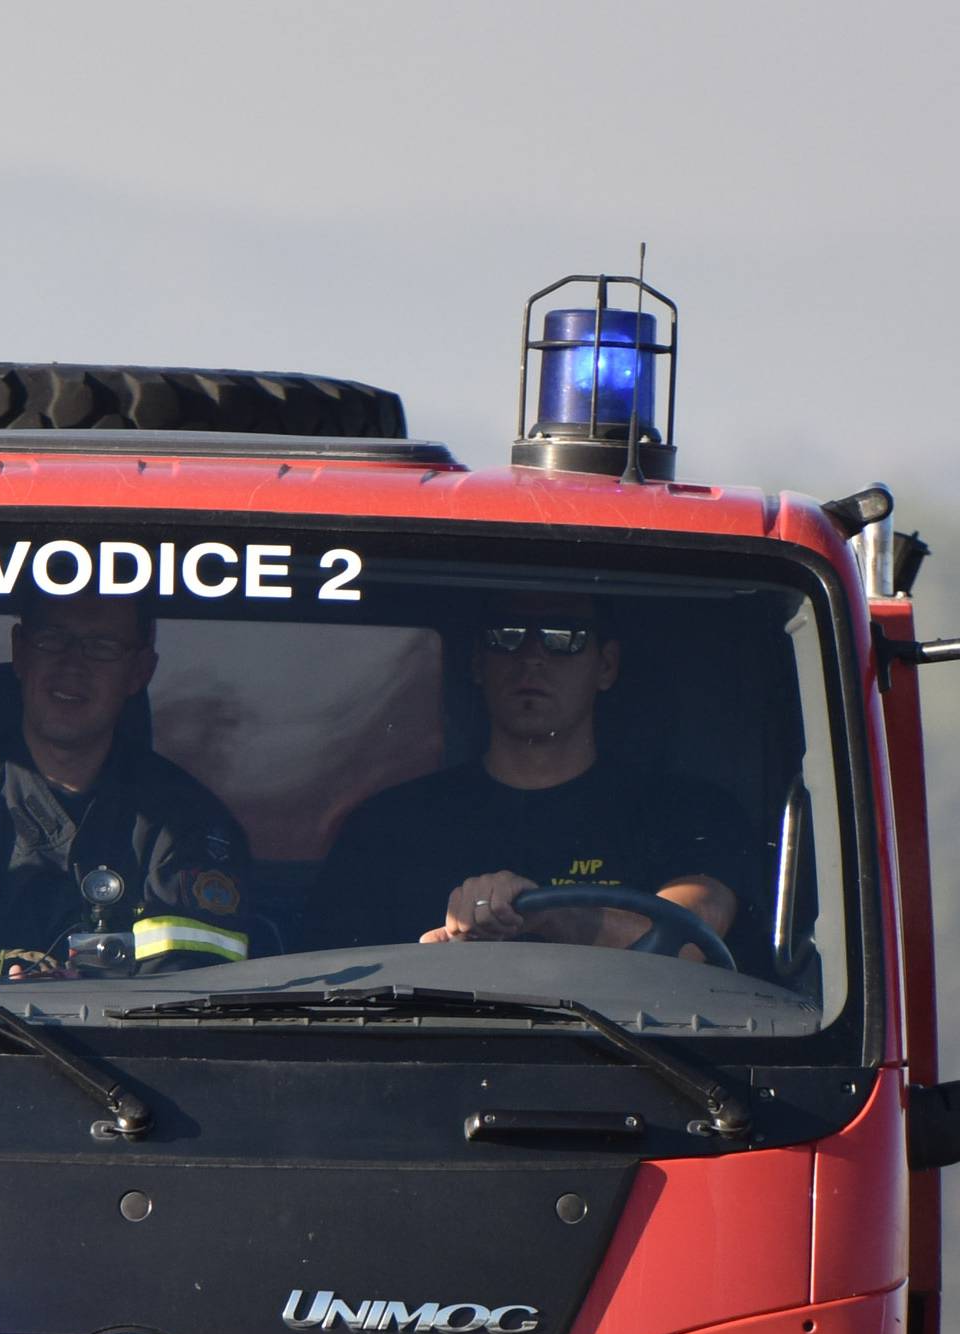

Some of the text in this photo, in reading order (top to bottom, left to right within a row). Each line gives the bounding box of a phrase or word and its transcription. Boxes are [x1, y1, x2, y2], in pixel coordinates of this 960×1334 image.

[317, 548, 363, 601] 2
[568, 858, 604, 876] JVP
[282, 1289, 539, 1334] UNIMOG
